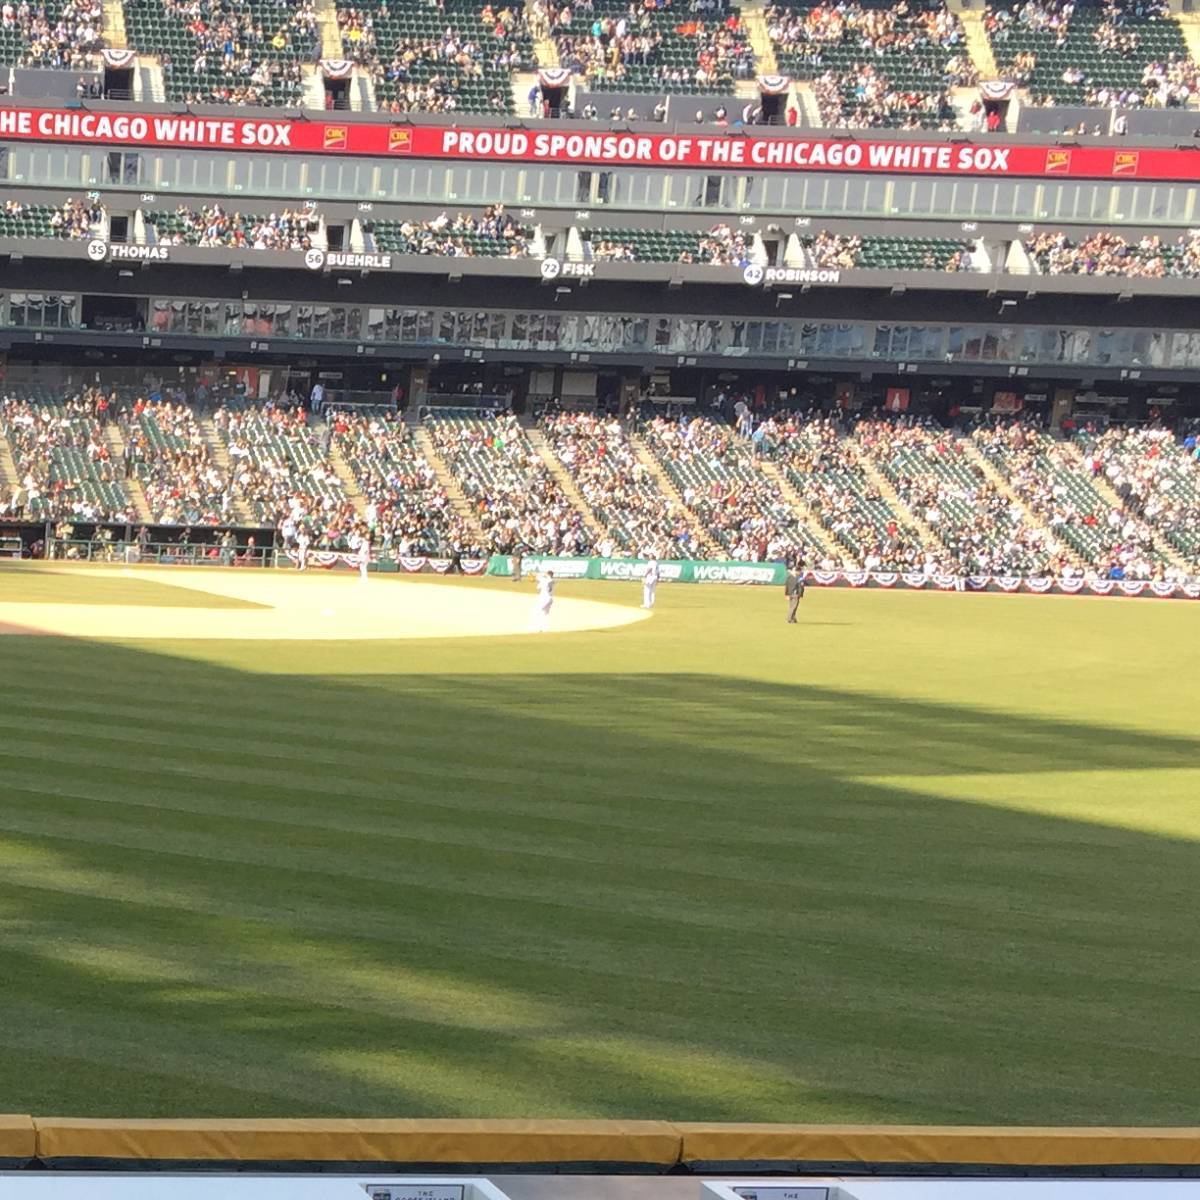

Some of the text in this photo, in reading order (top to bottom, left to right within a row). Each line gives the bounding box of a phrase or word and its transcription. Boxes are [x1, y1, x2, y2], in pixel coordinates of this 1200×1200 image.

[38, 112, 147, 140] CHICAGO
[153, 118, 234, 144] WHITE
[241, 123, 291, 146] SOX
[443, 131, 1009, 171] PROUD SPONSOR OF THE CHICAGO WHITE SOX
[91, 245, 168, 259] 35 THOMAS
[308, 254, 391, 267] 56 BUEHRLE
[544, 263, 594, 276] 72 FISK
[746, 269, 840, 282] 42 ROBINSON
[600, 561, 634, 576] WGN
[693, 565, 732, 579] WGN
